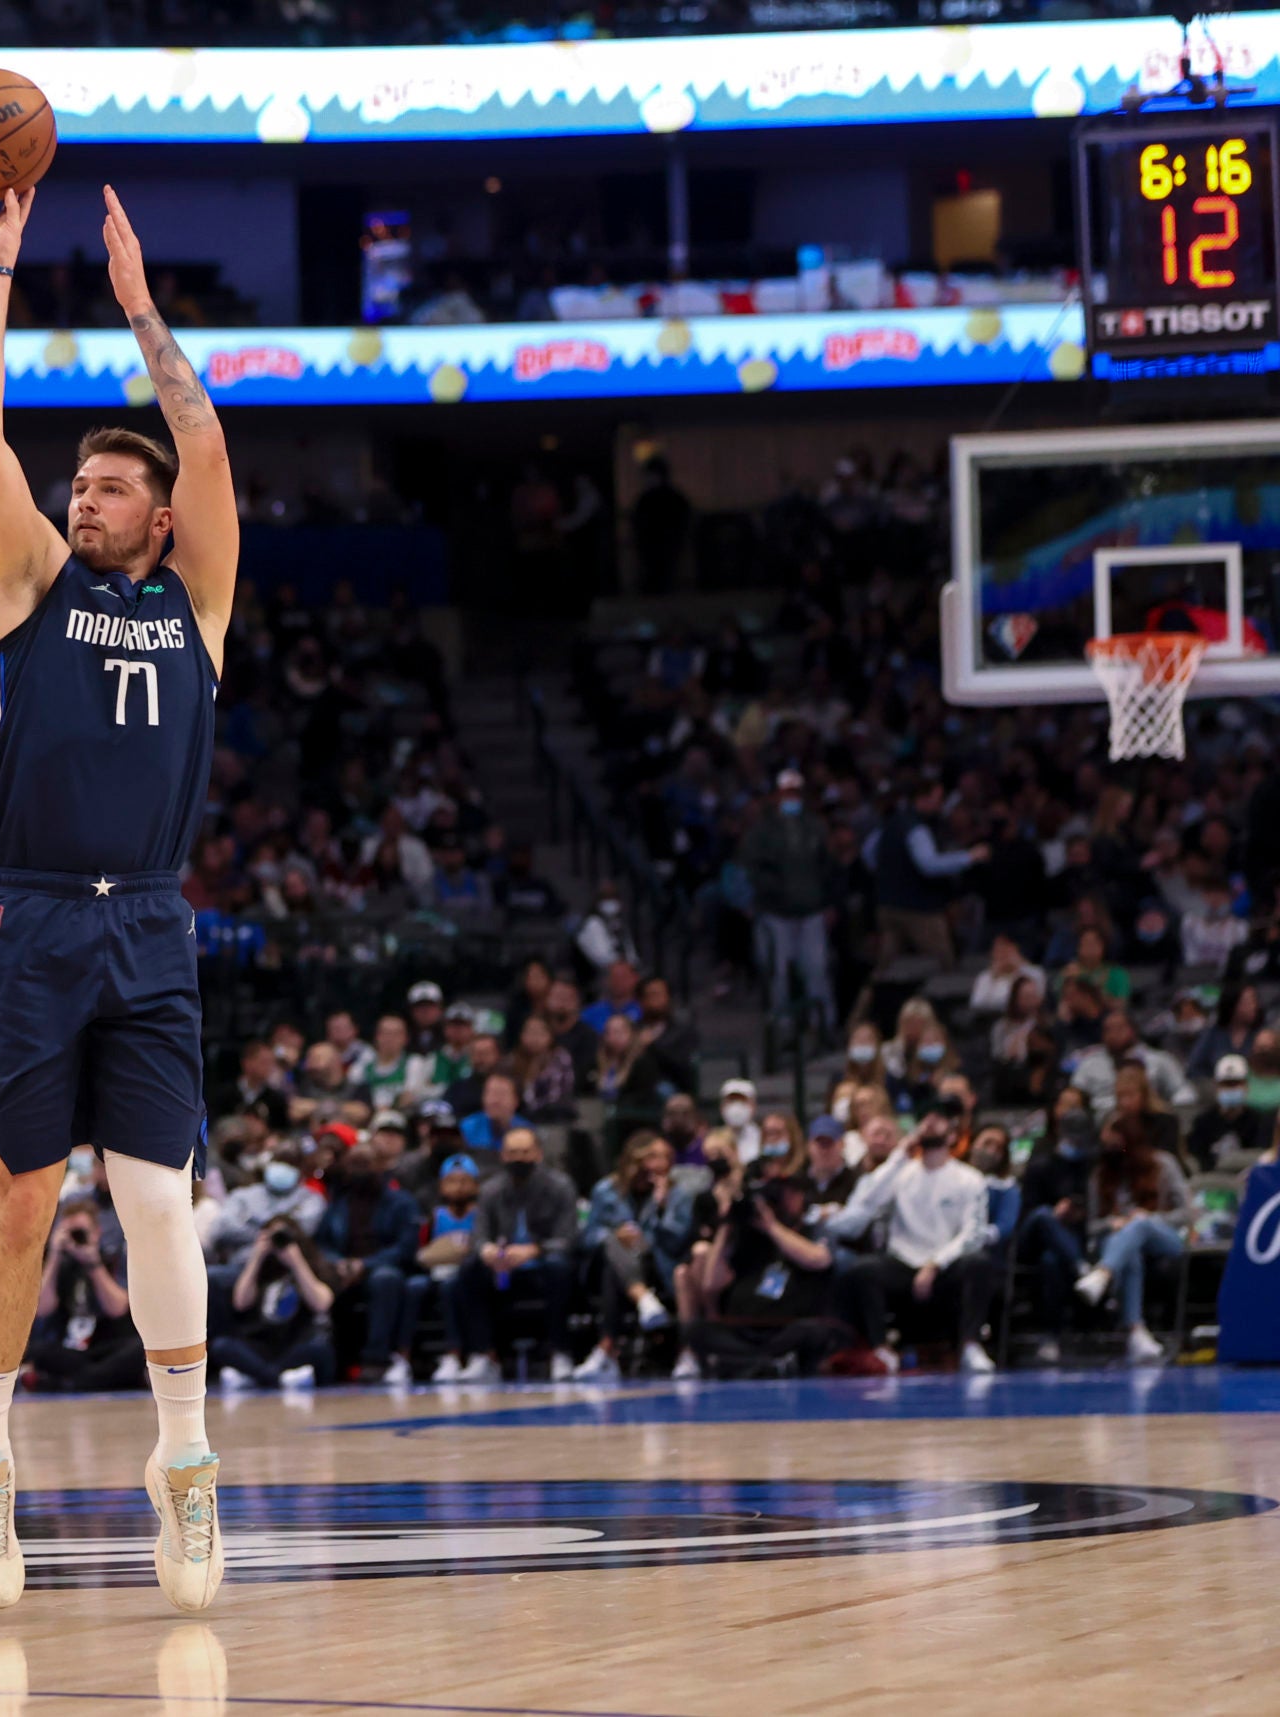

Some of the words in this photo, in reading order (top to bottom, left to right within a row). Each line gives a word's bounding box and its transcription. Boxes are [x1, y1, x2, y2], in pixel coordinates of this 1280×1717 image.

[1140, 139, 1252, 200] 6:16
[1161, 196, 1239, 288] 12
[1146, 301, 1271, 336] TISSOT
[65, 608, 186, 652] MAVRICKS
[103, 658, 160, 727] 77
